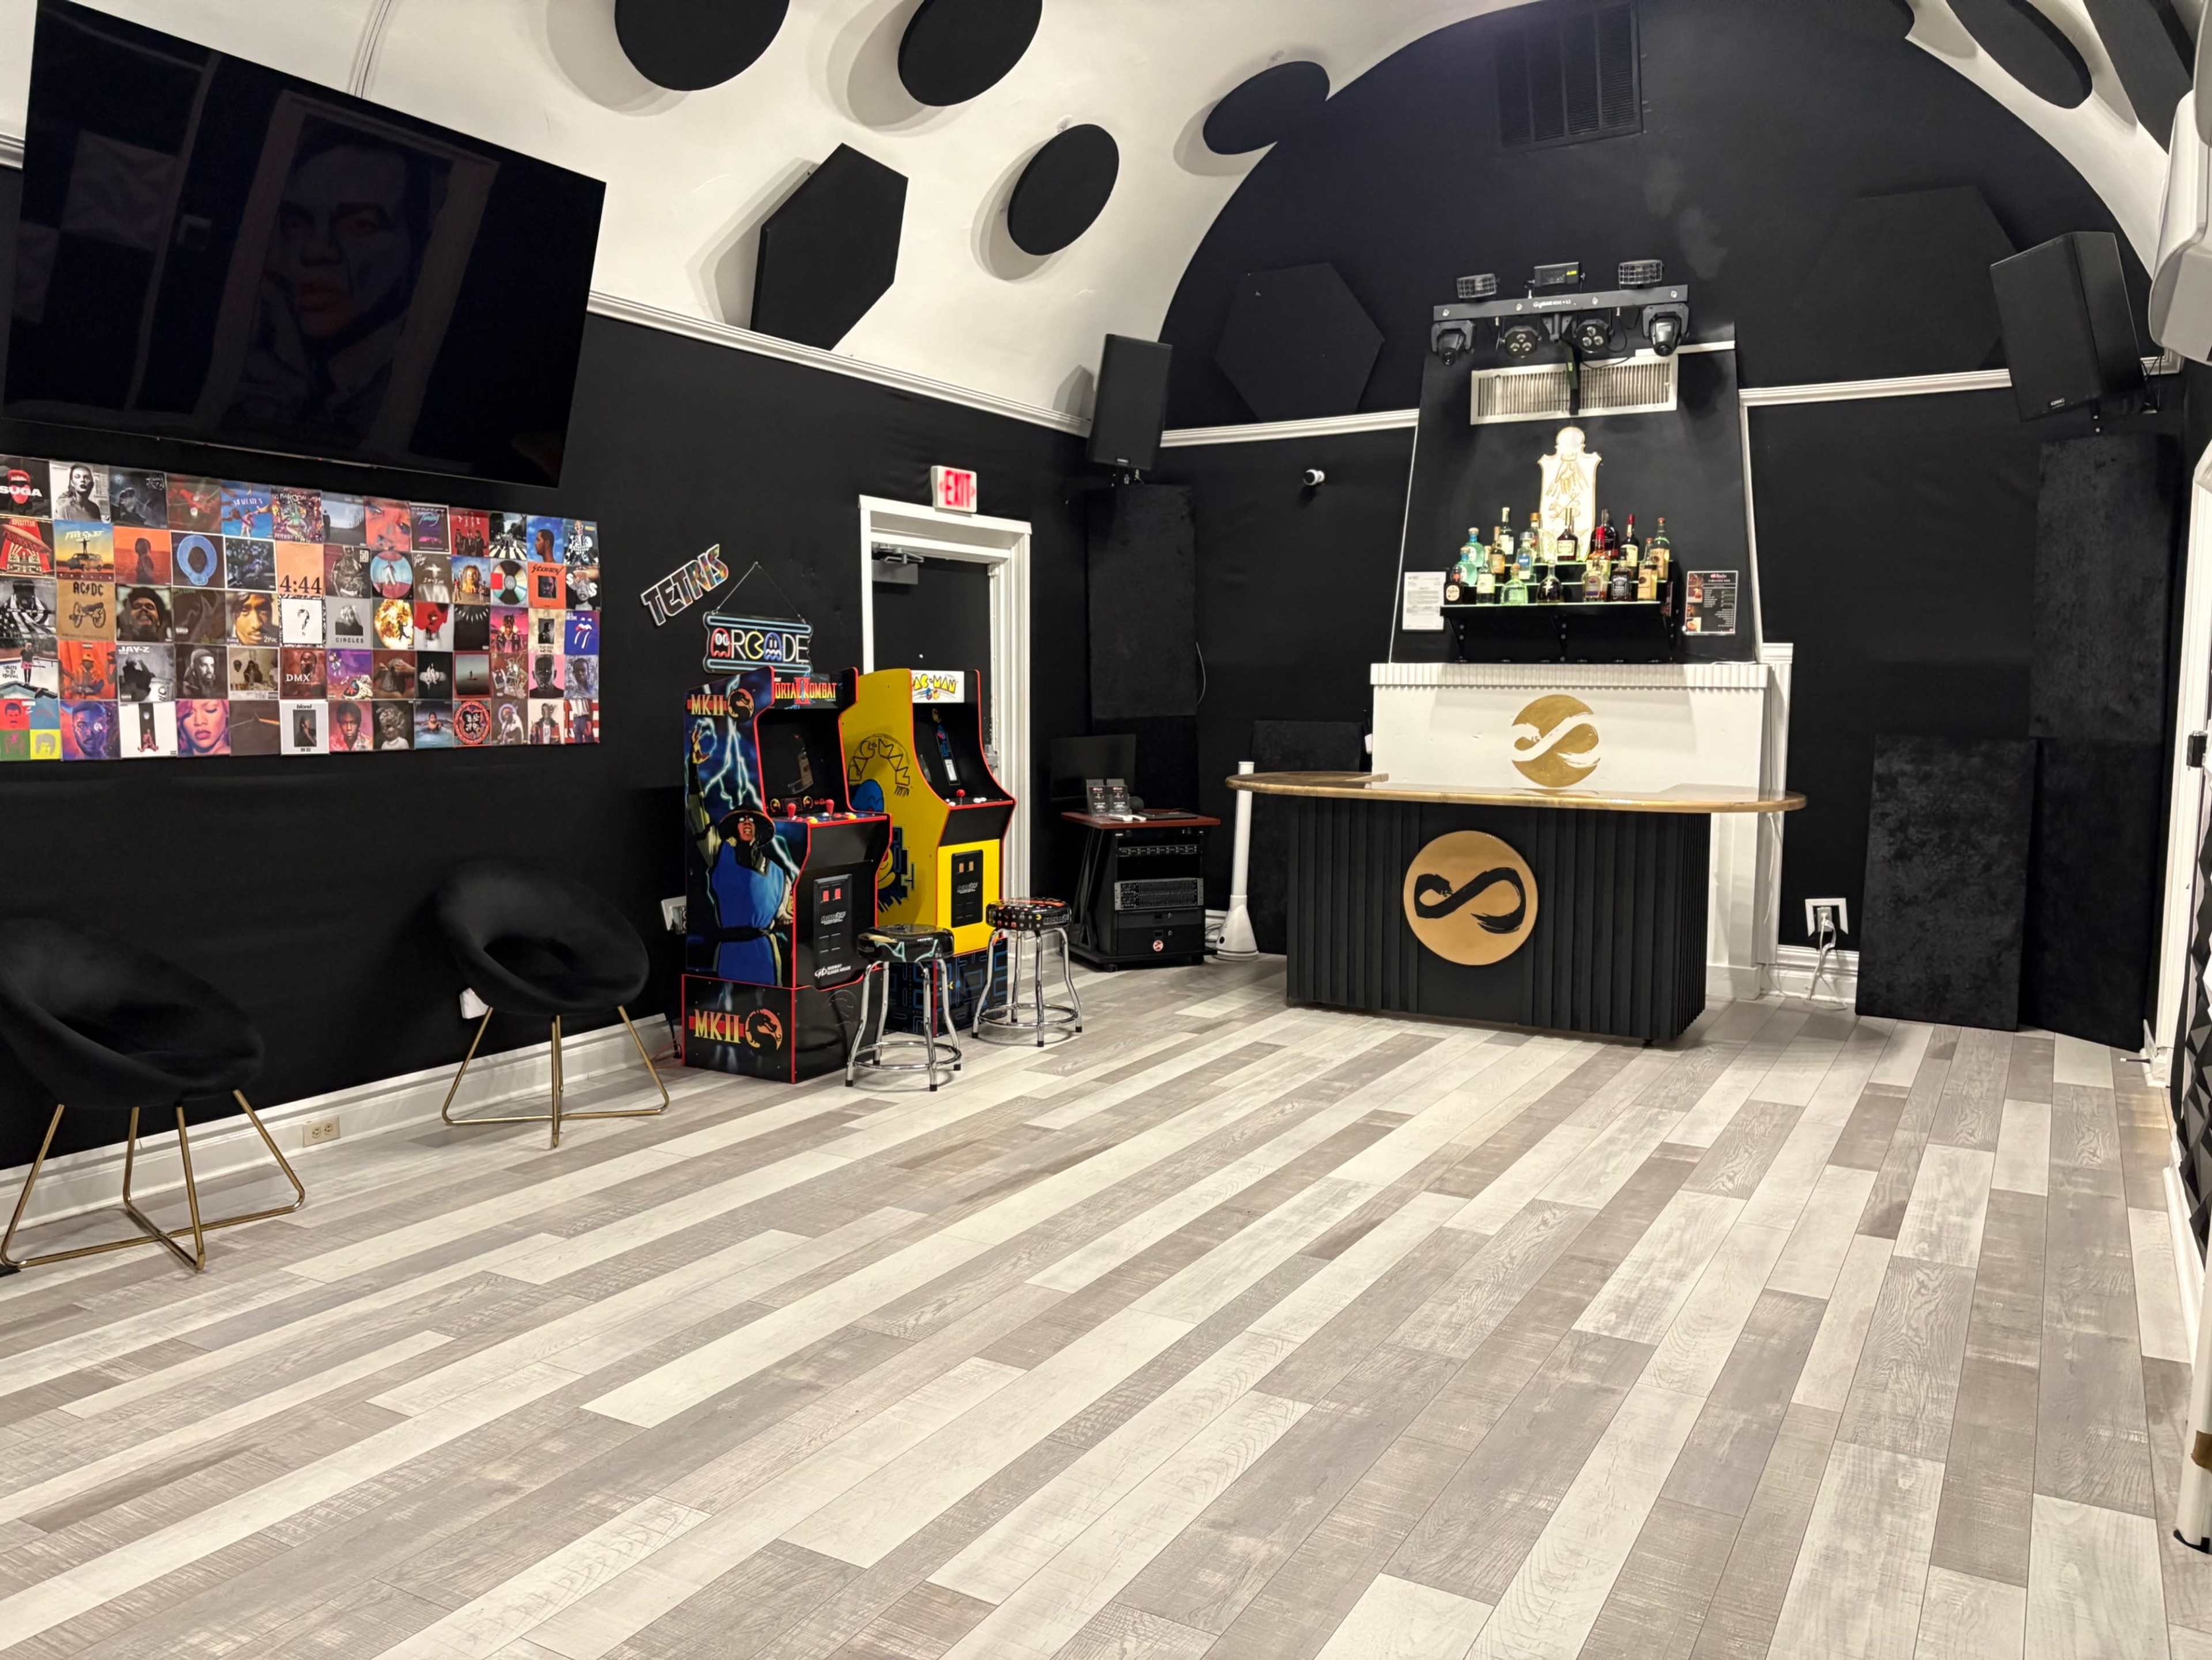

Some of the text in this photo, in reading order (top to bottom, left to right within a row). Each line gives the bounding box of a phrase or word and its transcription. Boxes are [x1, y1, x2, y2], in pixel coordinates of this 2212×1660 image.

[945, 470, 971, 507] EXIT
[279, 574, 323, 595] 4:44
[641, 543, 729, 626] TETRIS
[710, 627, 810, 663] ARCADE
[286, 674, 310, 682] DMX
